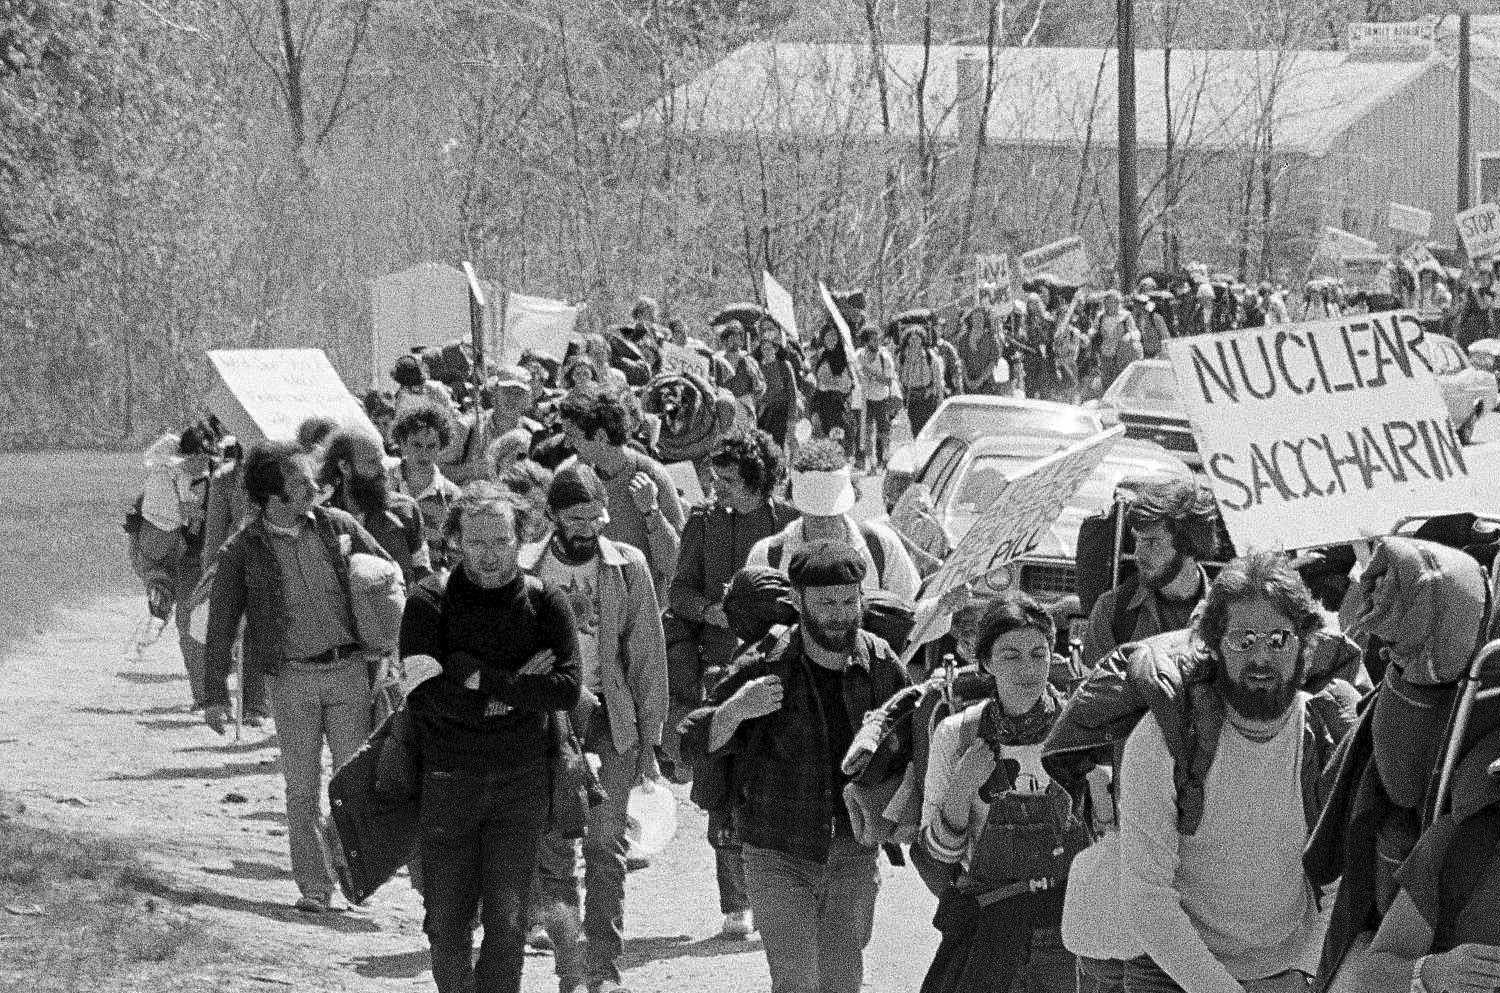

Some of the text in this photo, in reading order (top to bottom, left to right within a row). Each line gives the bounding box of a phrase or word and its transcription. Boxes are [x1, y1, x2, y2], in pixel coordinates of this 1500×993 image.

[1463, 211, 1497, 238] STOP
[1190, 315, 1435, 404] NUCLEAR
[1209, 418, 1468, 510] SACCHARIN
